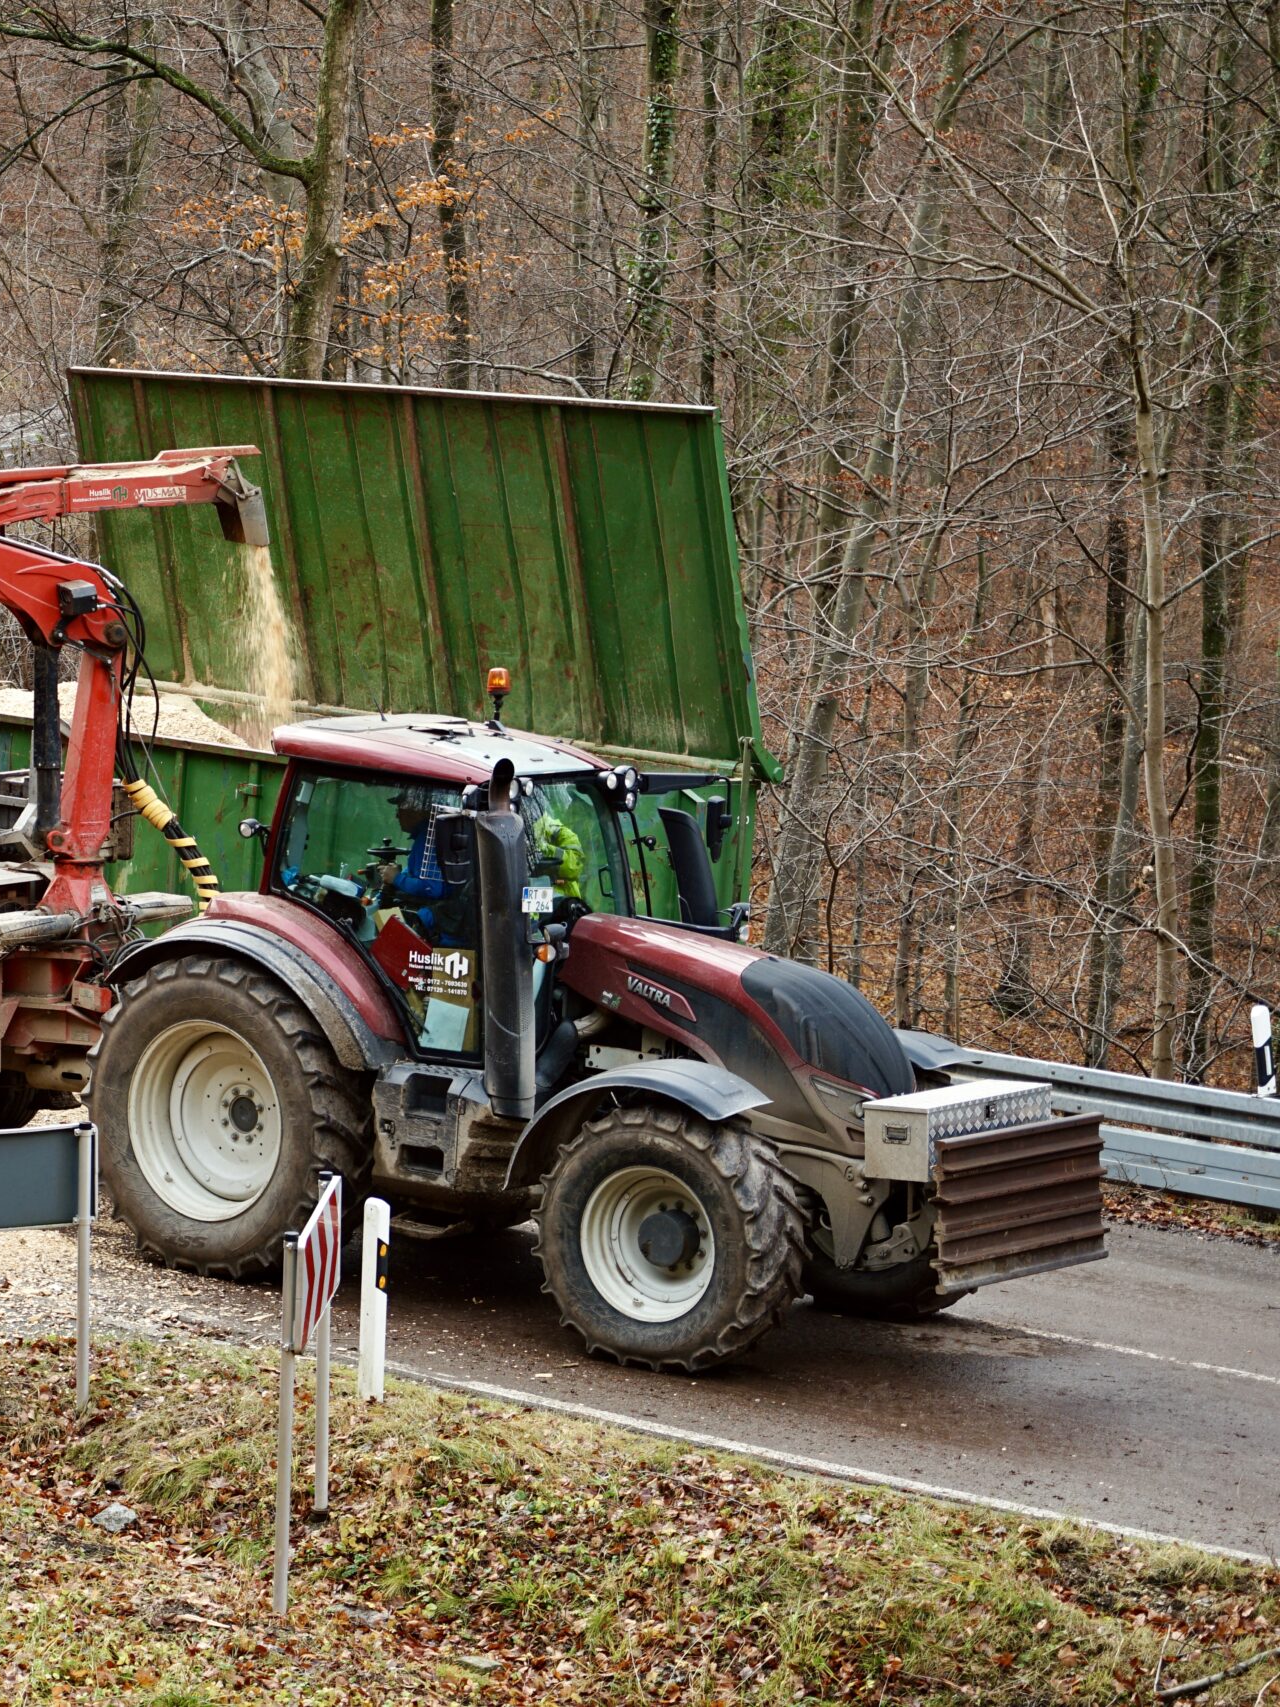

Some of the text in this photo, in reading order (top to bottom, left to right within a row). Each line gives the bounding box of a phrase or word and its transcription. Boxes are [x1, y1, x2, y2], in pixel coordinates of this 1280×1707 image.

[89, 488, 112, 497] Huslik
[135, 486, 186, 502] MUS-MAX
[528, 889, 538, 899] RT
[527, 900, 550, 911] T 264
[409, 950, 444, 966] Huslik
[627, 976, 671, 1007] VALTRA
